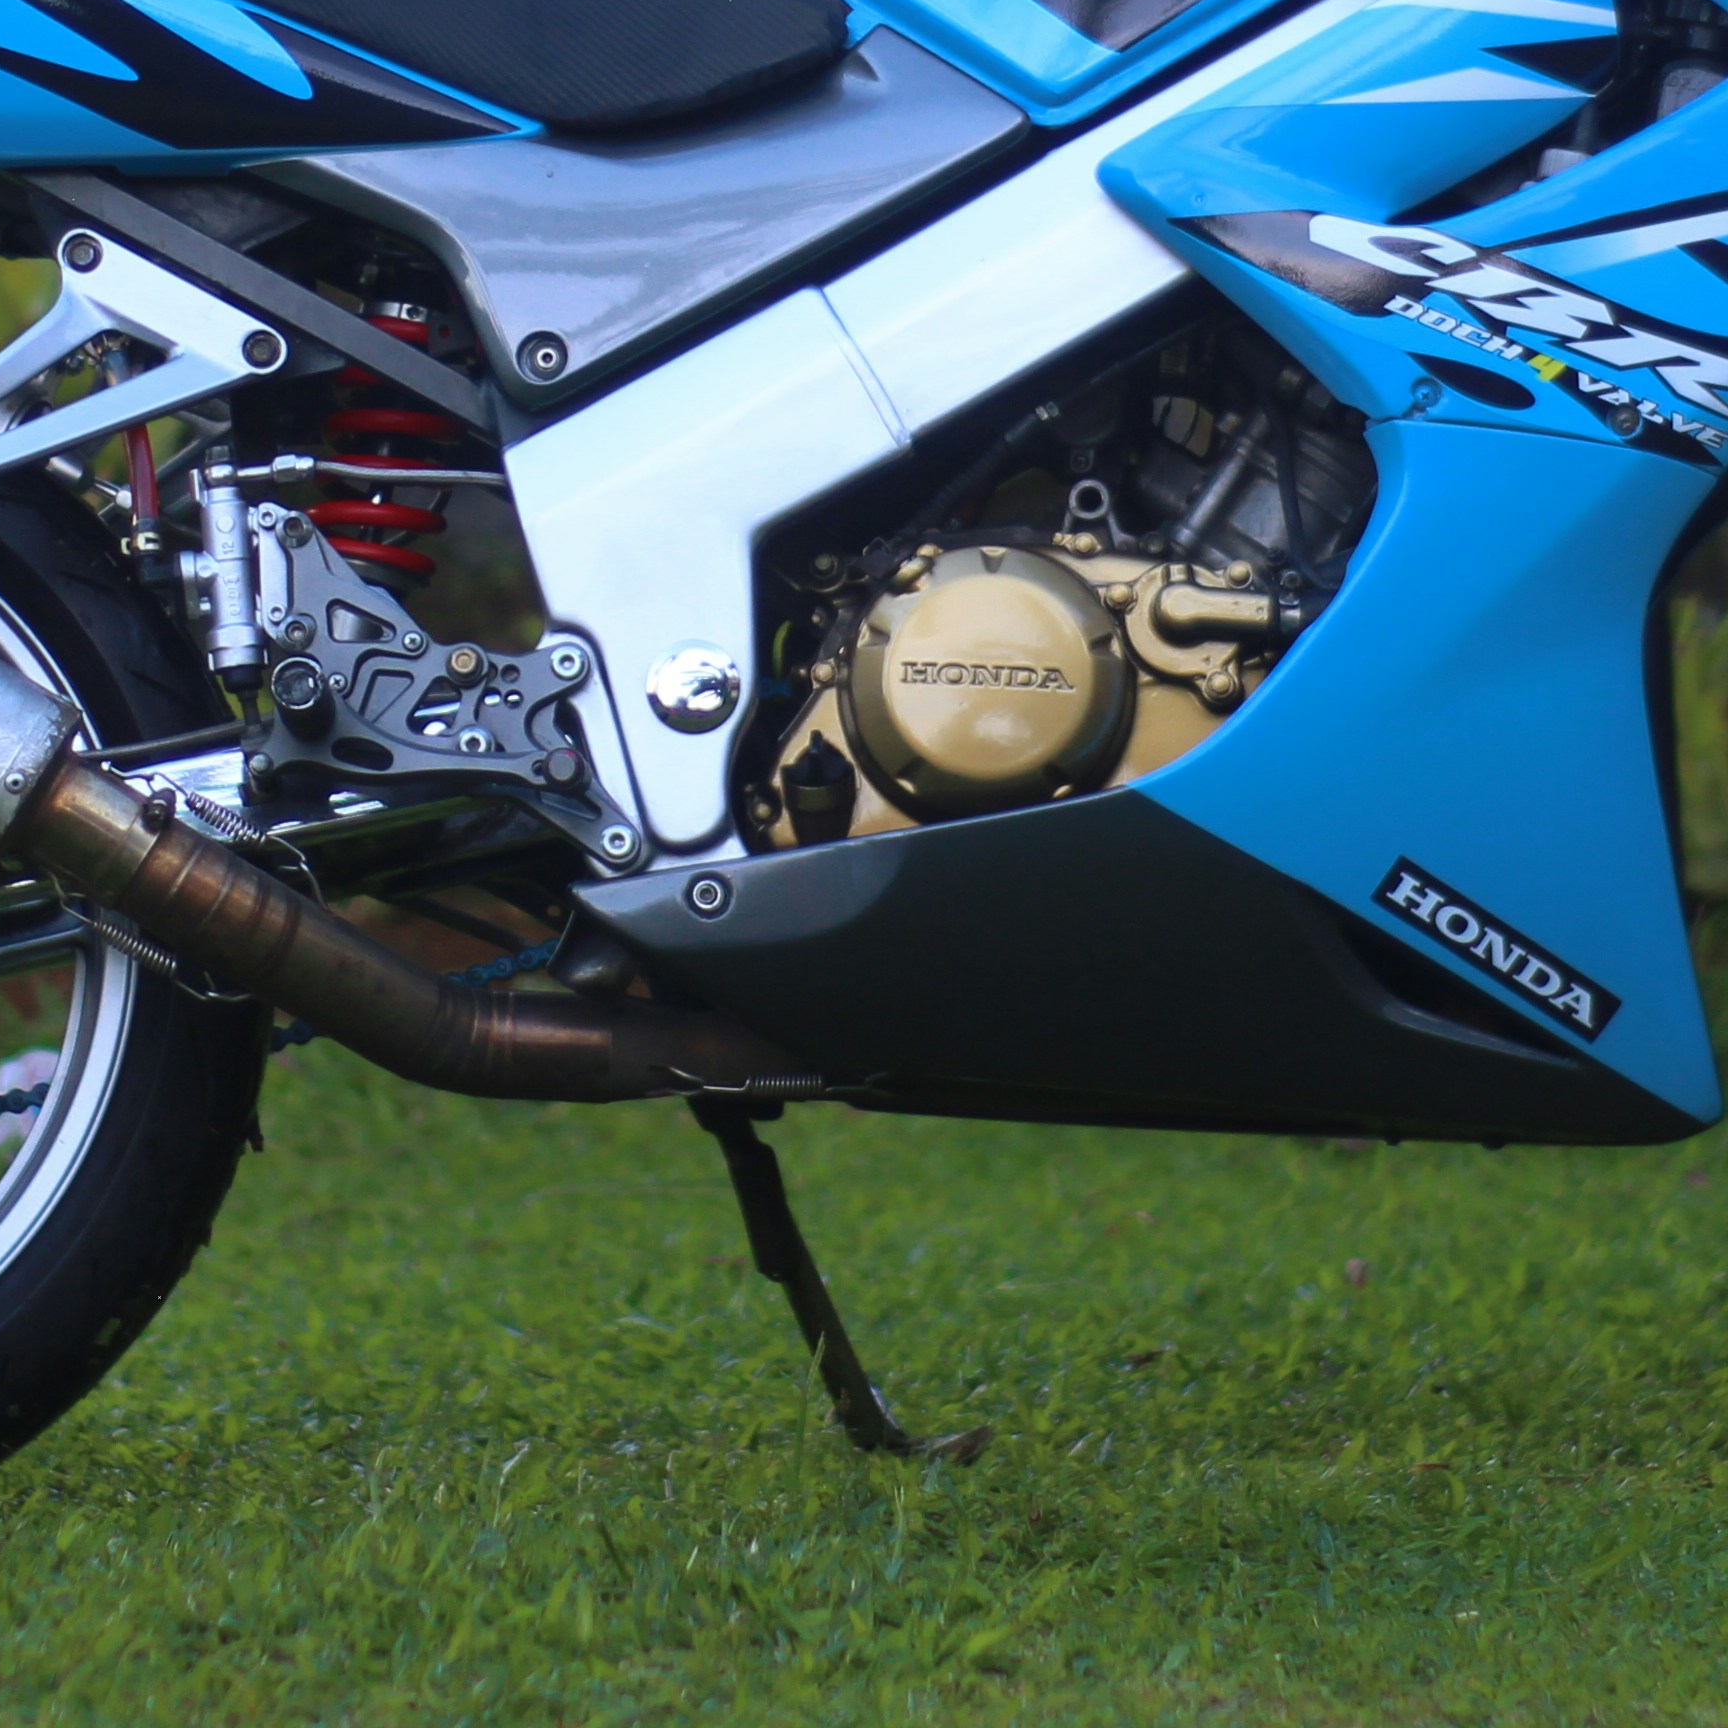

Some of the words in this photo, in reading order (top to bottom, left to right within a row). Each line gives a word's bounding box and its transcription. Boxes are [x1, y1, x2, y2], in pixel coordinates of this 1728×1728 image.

[1383, 294, 1523, 362] DOCH
[1527, 353, 1569, 383] 4
[900, 659, 1076, 693] HONDA
[1386, 872, 1593, 1029] HONDA
